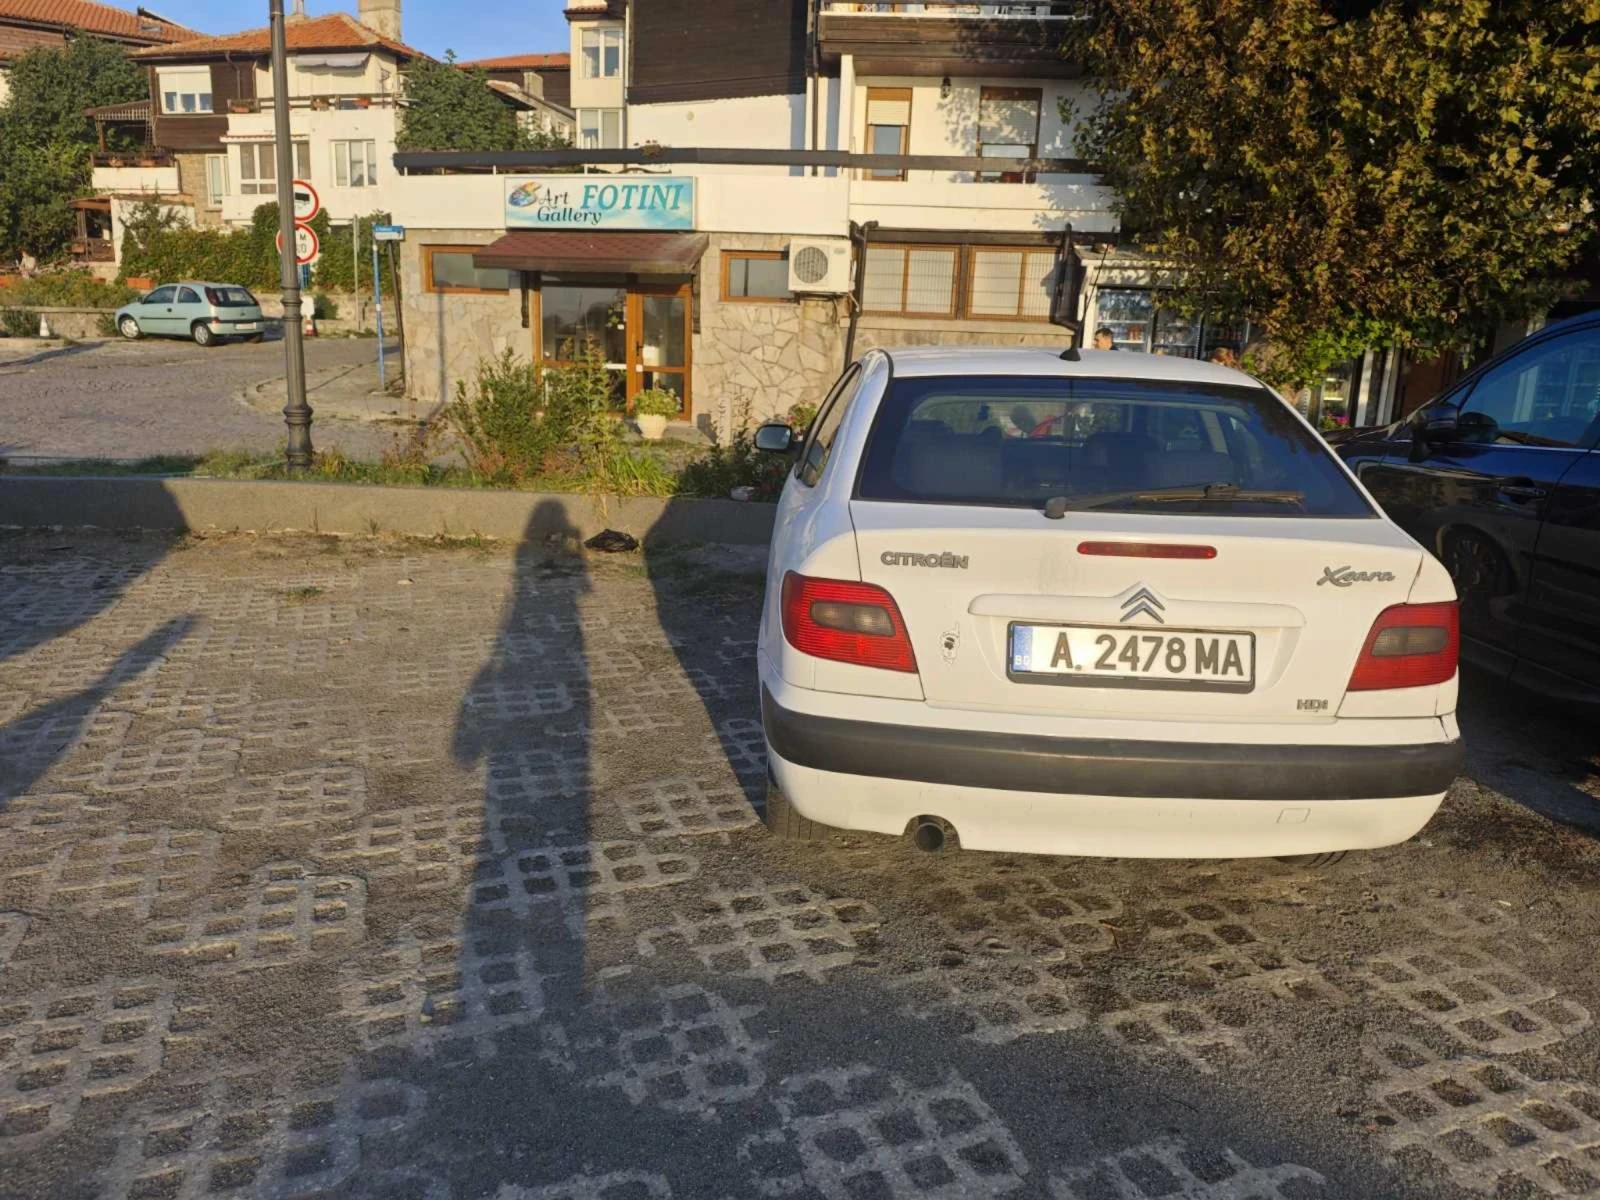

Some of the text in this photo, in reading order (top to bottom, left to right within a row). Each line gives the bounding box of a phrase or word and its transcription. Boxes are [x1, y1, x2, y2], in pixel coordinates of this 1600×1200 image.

[539, 187, 568, 209] Art
[580, 184, 685, 210] FOTINI
[537, 206, 602, 226] Gallery
[880, 550, 969, 570] CITROËN
[1014, 654, 1031, 666] BG
[1094, 633, 1187, 674] 2478
[1195, 637, 1244, 677] MA
